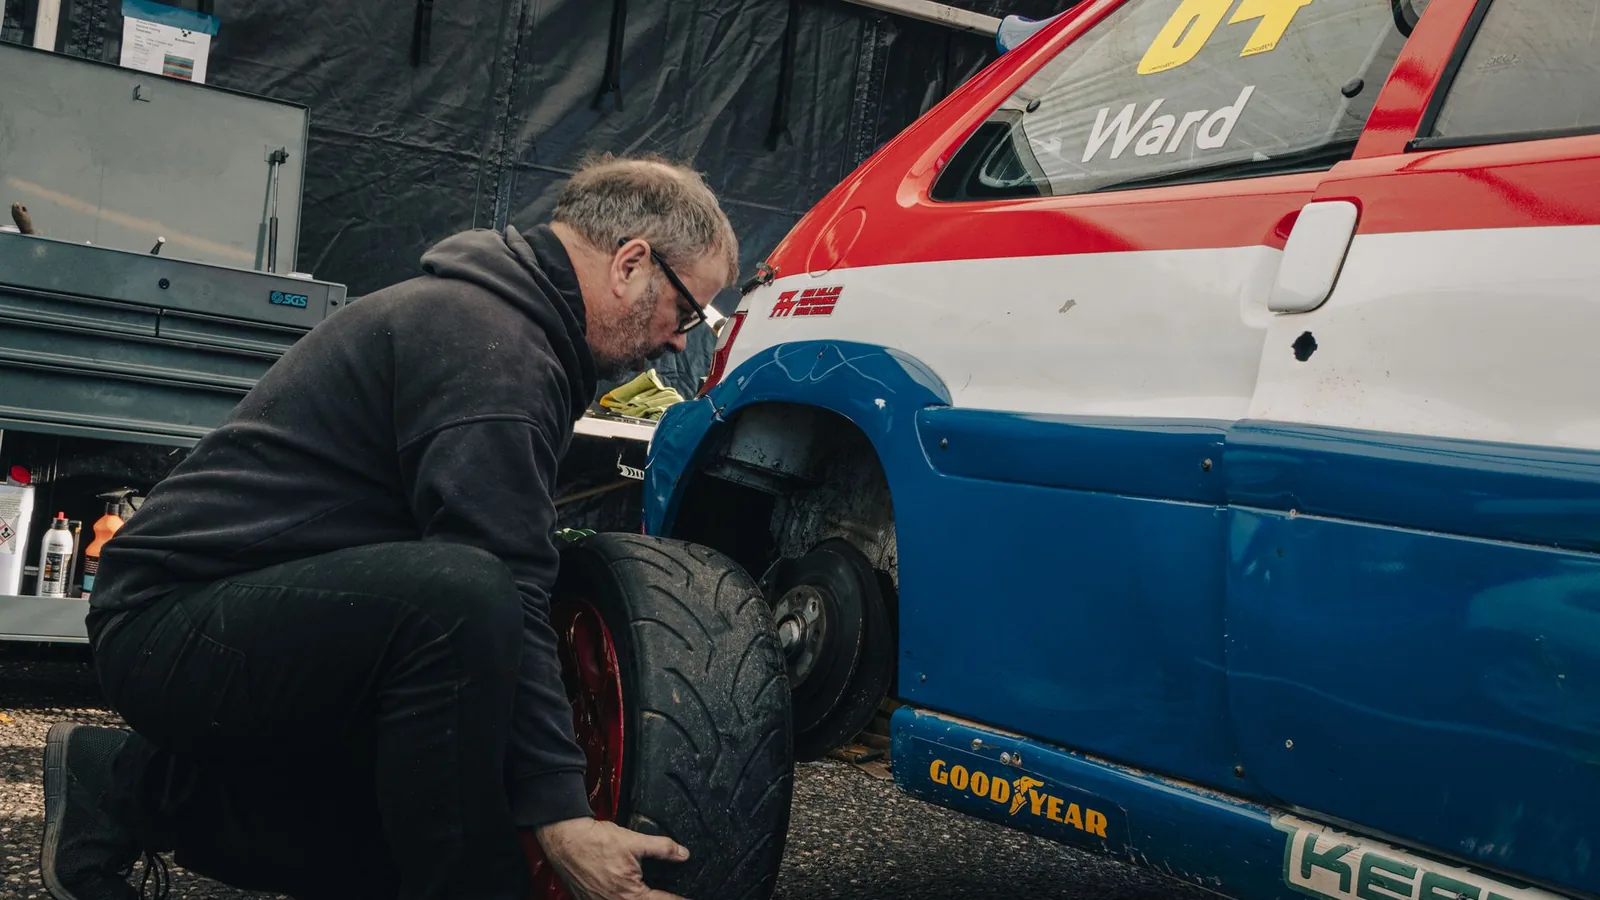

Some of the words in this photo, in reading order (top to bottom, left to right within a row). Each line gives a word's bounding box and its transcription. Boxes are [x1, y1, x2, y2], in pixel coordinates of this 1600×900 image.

[1081, 85, 1256, 163] Ward
[282, 294, 307, 307] SGS
[1301, 833, 1518, 900] KE
